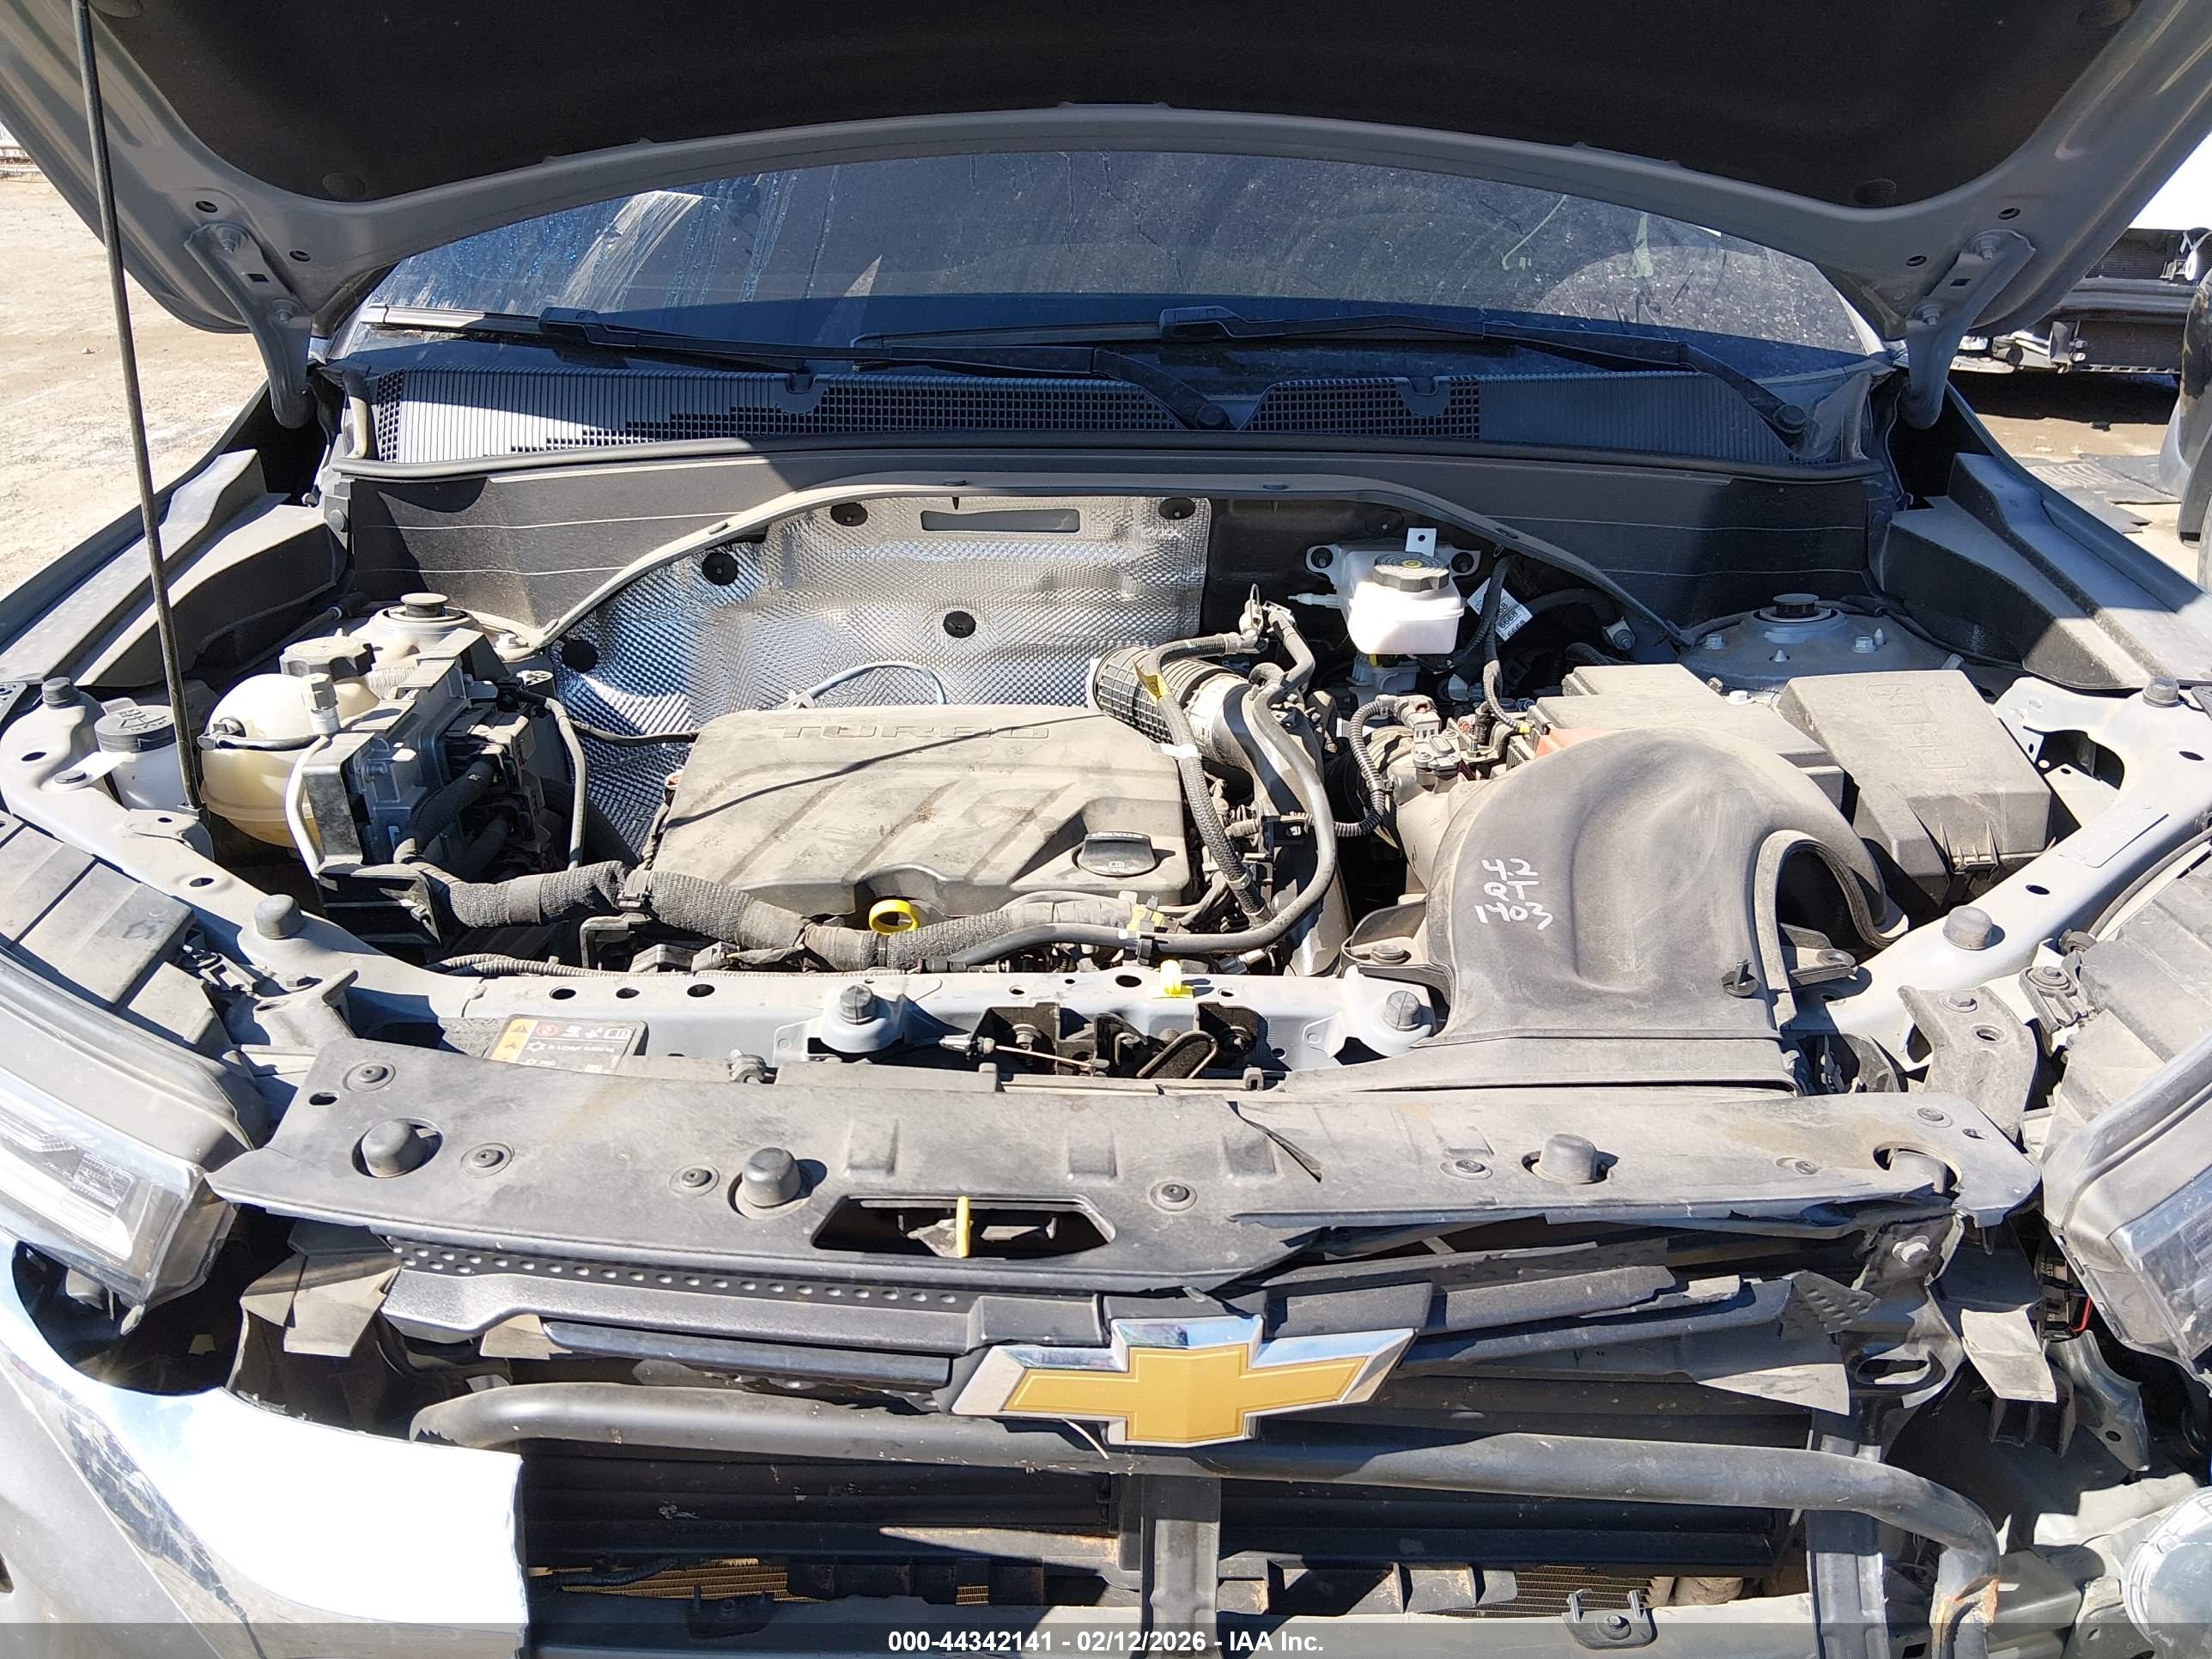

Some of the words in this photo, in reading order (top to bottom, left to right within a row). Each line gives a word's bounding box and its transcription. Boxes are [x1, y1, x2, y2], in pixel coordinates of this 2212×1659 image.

[768, 725, 1049, 738] TURBO
[1483, 880, 1540, 902] QT
[1474, 902, 1553, 930] 1403
